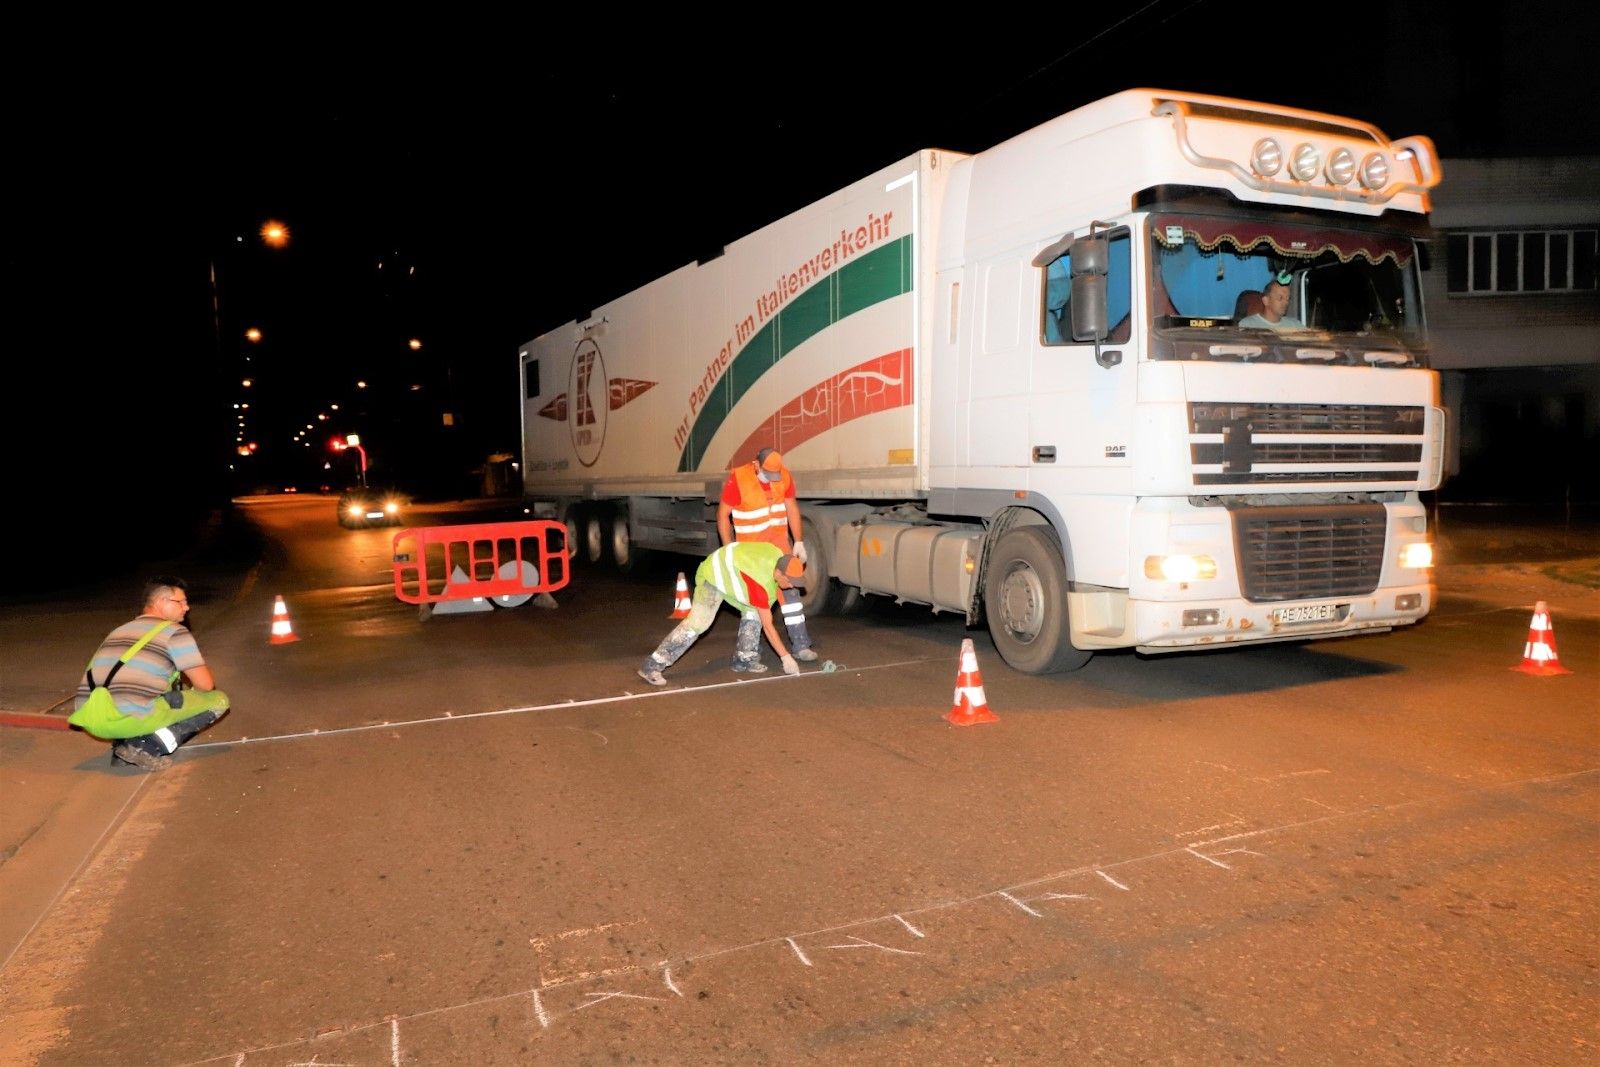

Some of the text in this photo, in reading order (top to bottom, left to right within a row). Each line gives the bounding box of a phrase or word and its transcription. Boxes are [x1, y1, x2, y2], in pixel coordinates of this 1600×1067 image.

[673, 210, 893, 452] Ihr Partner im Italienverkehr
[1189, 319, 1213, 328] DAF
